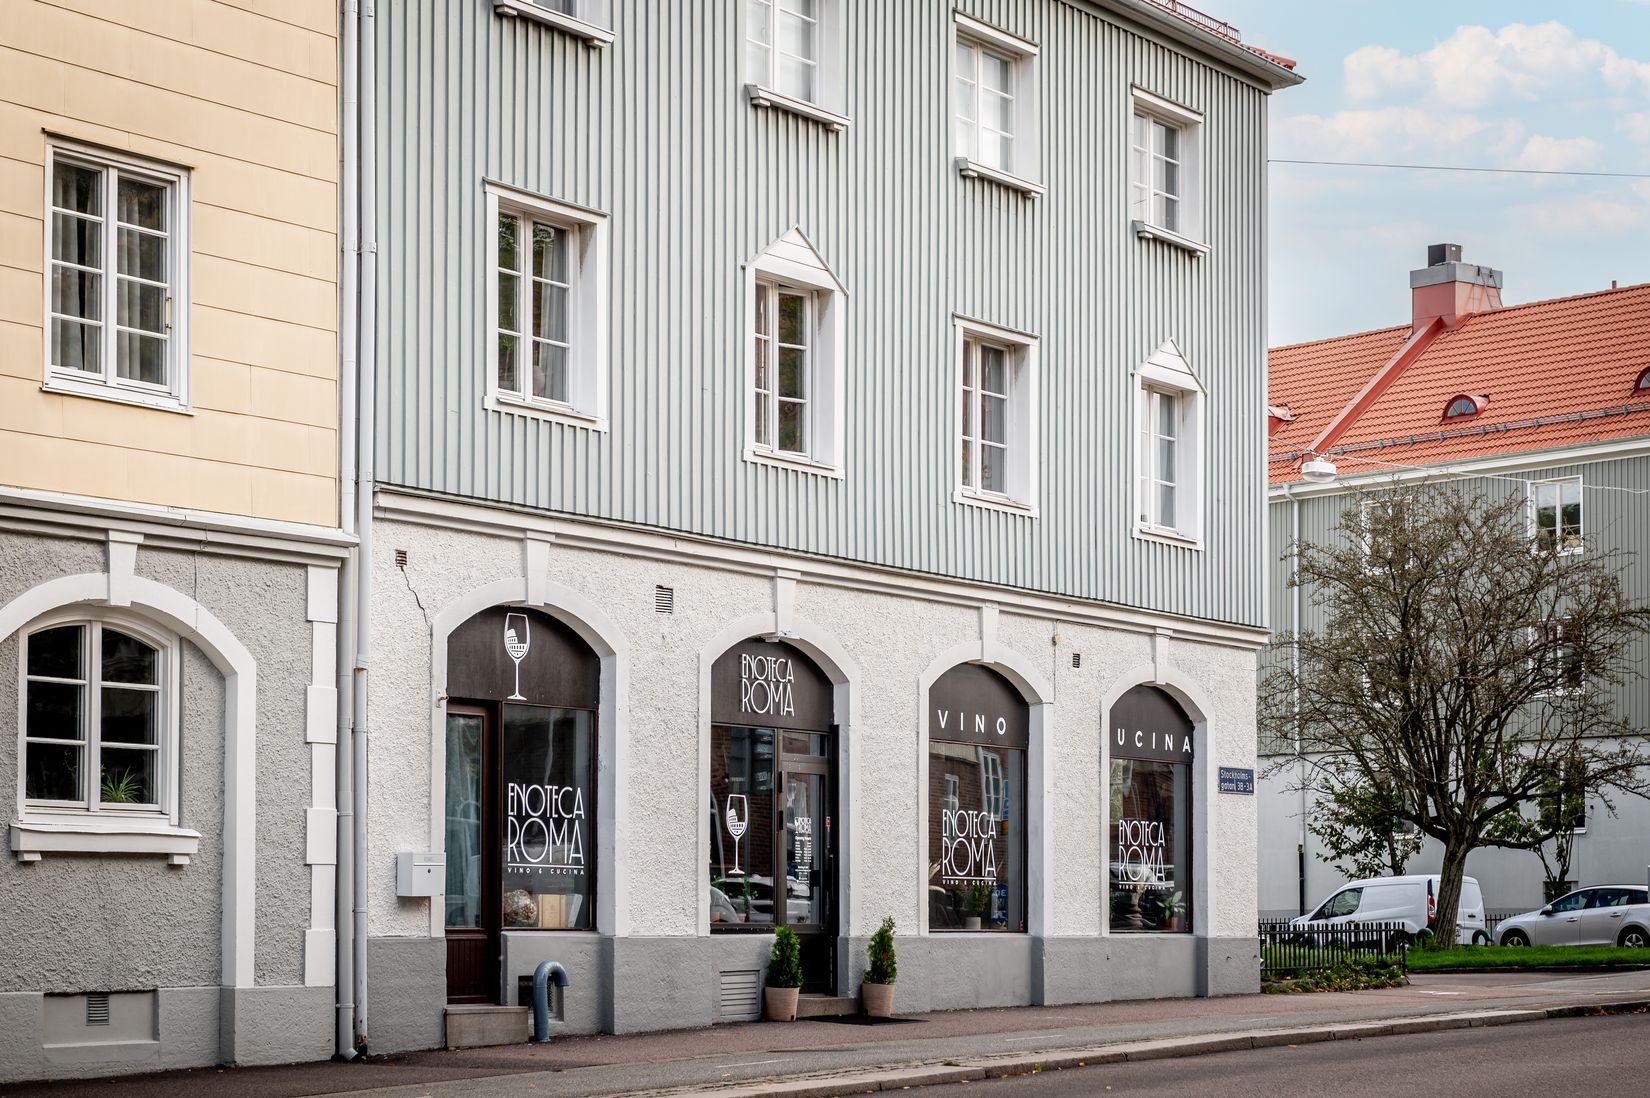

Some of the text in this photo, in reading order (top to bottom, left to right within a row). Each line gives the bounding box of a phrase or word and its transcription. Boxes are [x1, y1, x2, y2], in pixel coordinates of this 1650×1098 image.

[742, 653, 794, 683] ENOTECA
[742, 679, 794, 716] ROMA
[937, 709, 1006, 735] VINO
[1117, 727, 1191, 753] UCINA
[508, 783, 585, 819] ENOTECA
[508, 816, 584, 864] ROMA
[942, 809, 997, 839] ENOTECA
[1119, 819, 1166, 847] ENOTECA
[942, 837, 997, 877] ROMA
[1118, 846, 1166, 882] ROMA
